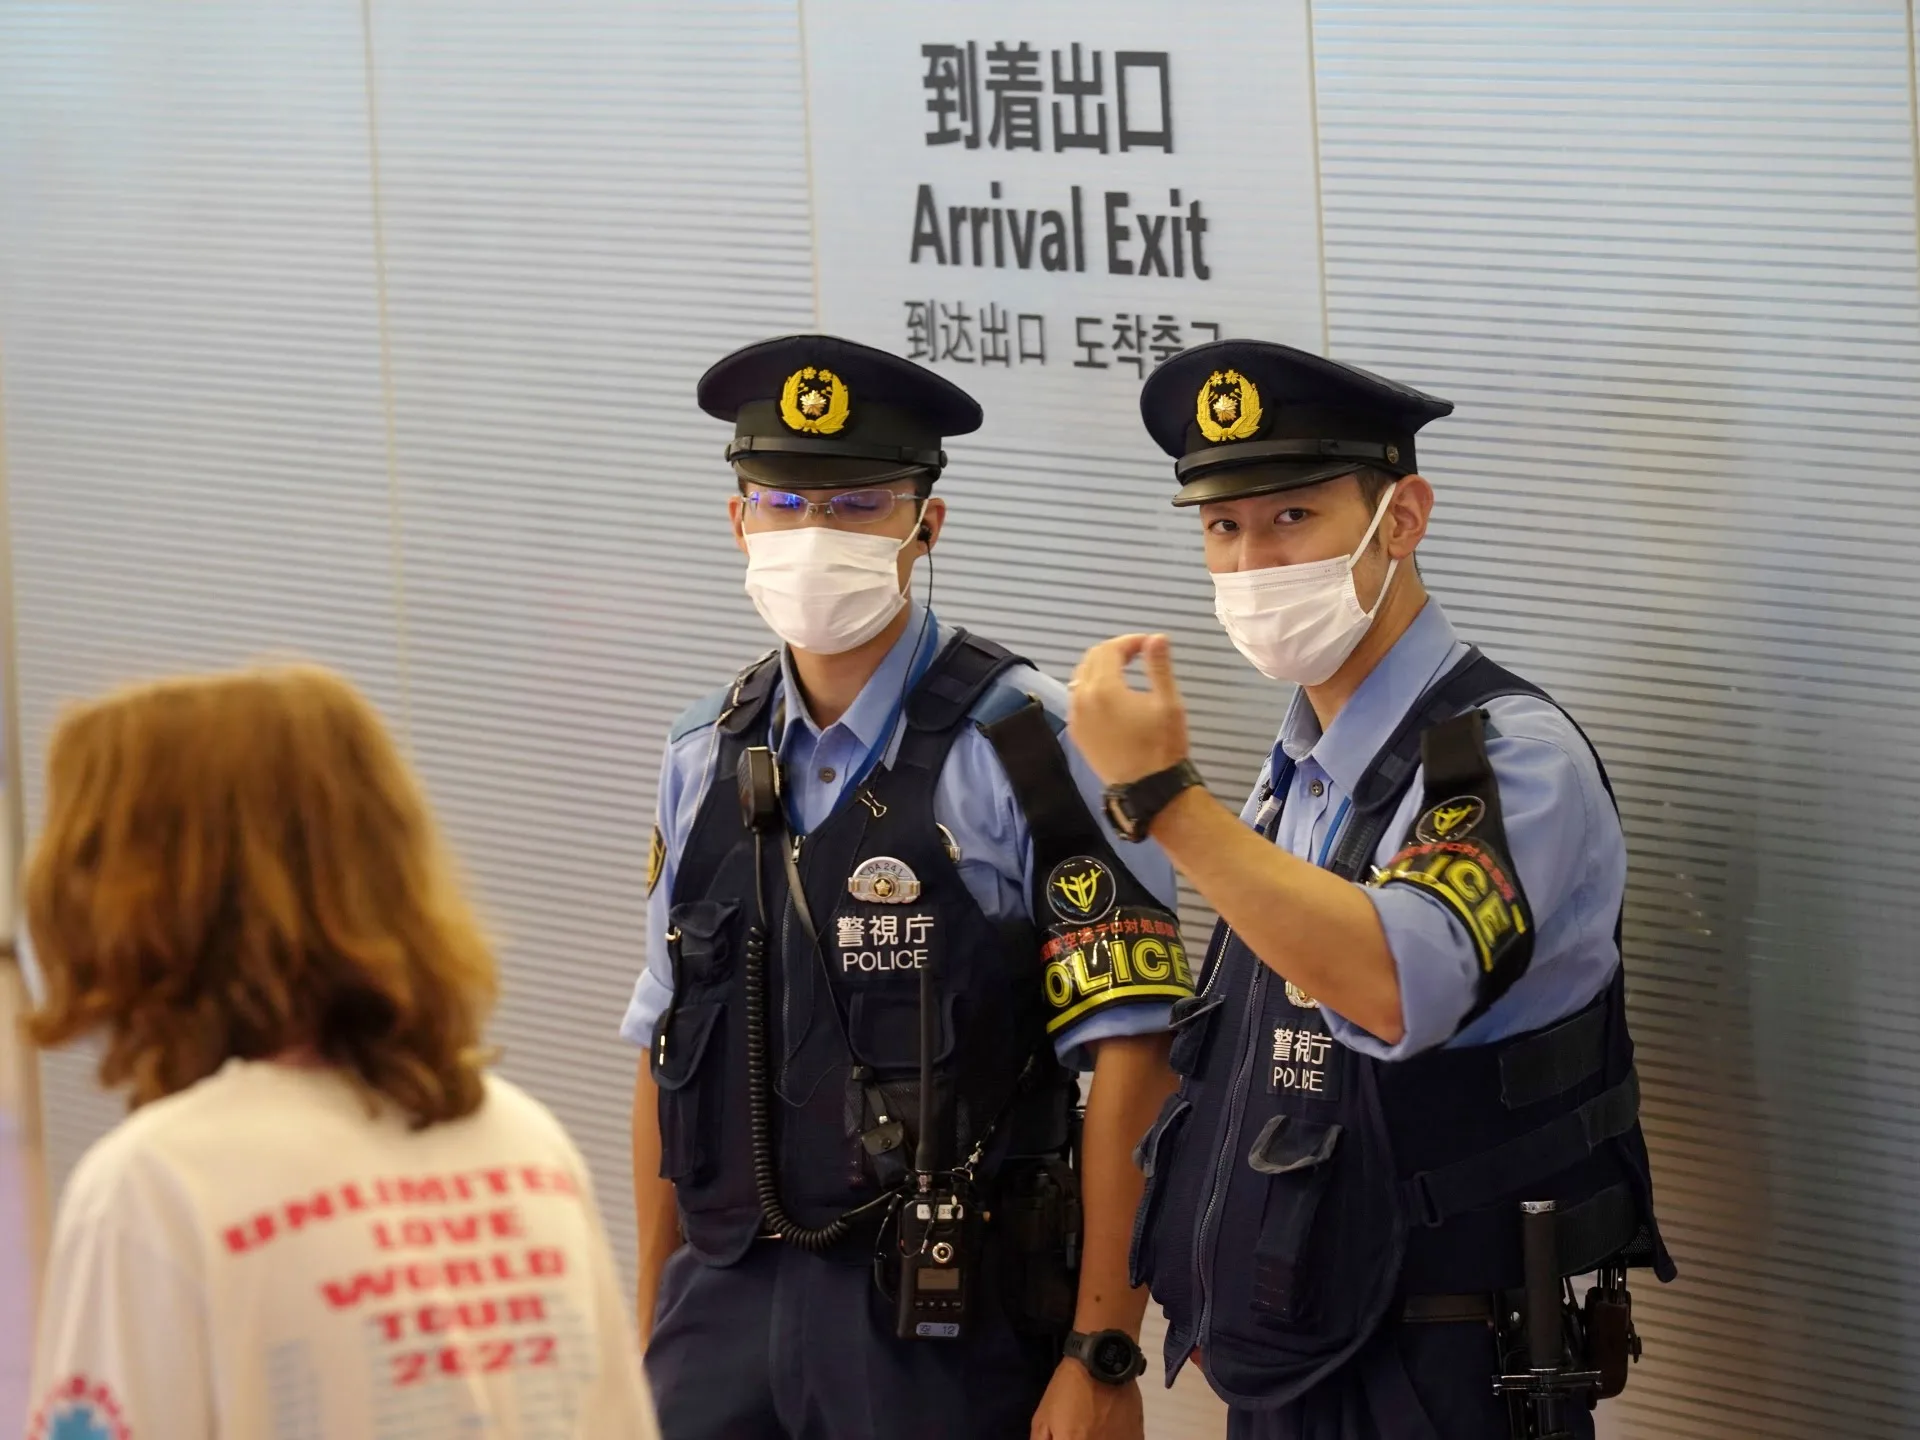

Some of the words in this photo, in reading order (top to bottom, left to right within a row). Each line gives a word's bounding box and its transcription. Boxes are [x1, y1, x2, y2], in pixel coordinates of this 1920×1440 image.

[921, 40, 1174, 154] 到着出口
[909, 181, 1086, 273] Arrival
[1104, 188, 1211, 281] Exit
[904, 299, 1046, 368] 到达出口
[836, 913, 935, 948] 警視庁
[843, 949, 929, 972] POLICE
[1045, 938, 1194, 1007] OLICE
[1272, 1028, 1333, 1065] 警視庁
[371, 1207, 524, 1251] LOVE
[320, 1248, 567, 1311] WORLD
[377, 1294, 547, 1342] TOUR
